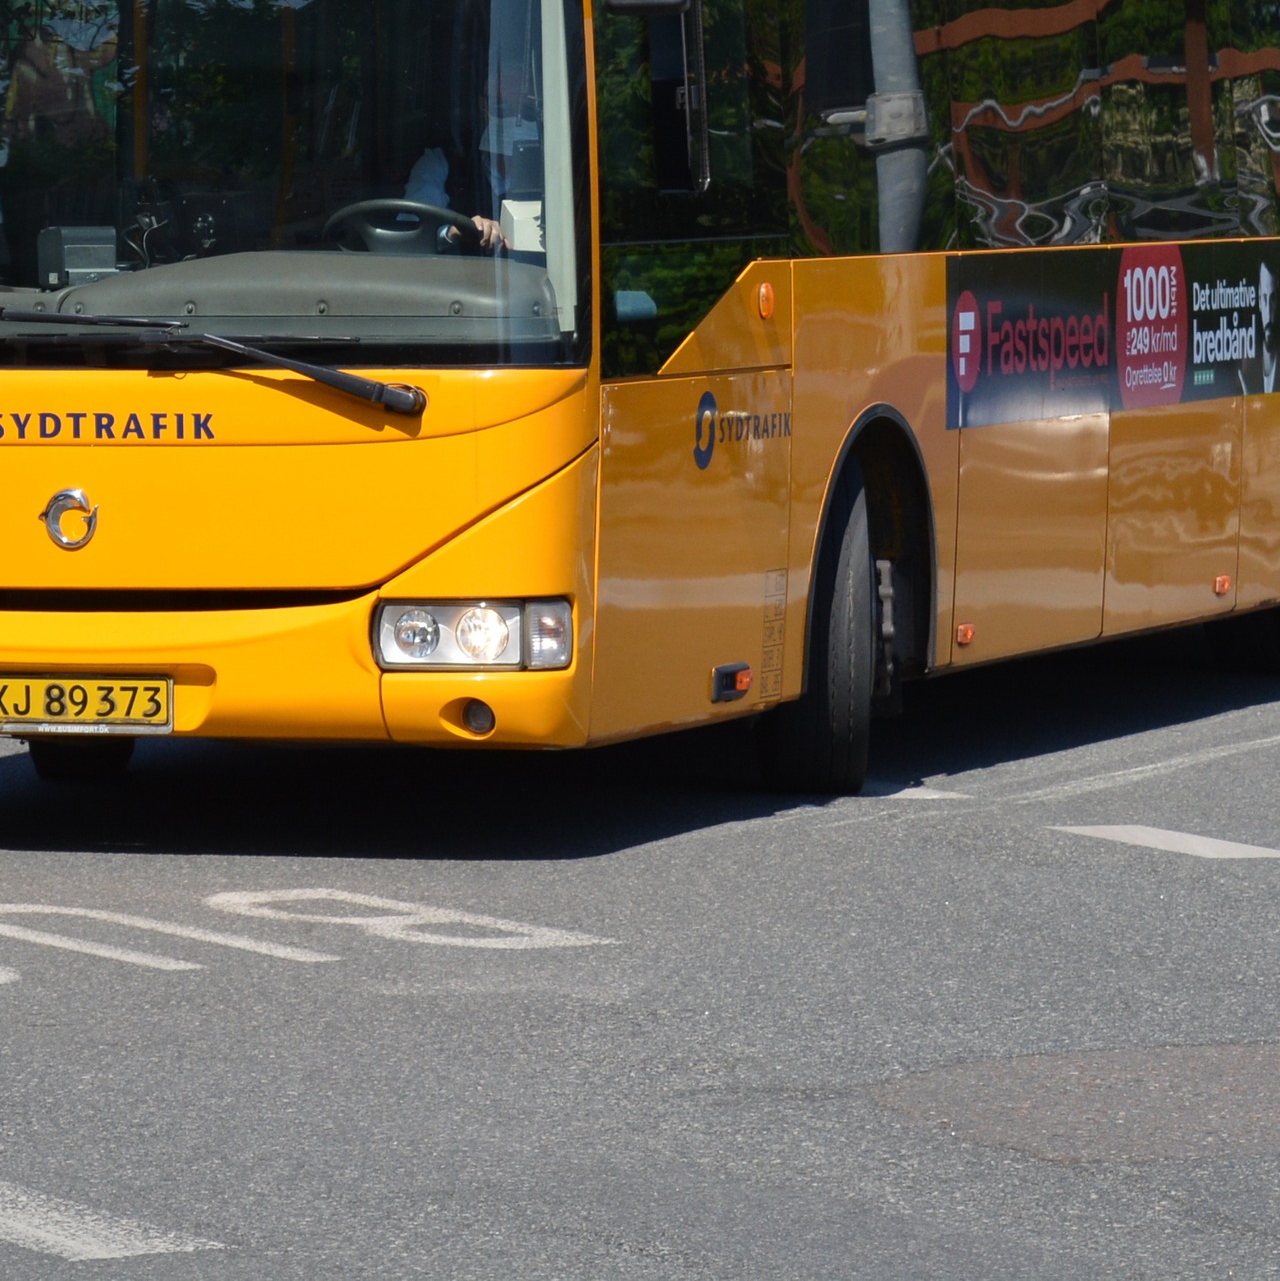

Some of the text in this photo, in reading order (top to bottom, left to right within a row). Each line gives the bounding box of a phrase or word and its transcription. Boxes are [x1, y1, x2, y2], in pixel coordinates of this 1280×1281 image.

[1123, 265, 1170, 323] 1000
[1193, 278, 1256, 312] Det ultimative
[986, 291, 1109, 392] Fastspeed
[1130, 326, 1151, 356] 249
[1151, 323, 1178, 354] kr/md
[1193, 311, 1256, 365] bredbånd
[1125, 362, 1162, 392] Oprettelse
[718, 412, 792, 444] SYDTRAFIK
